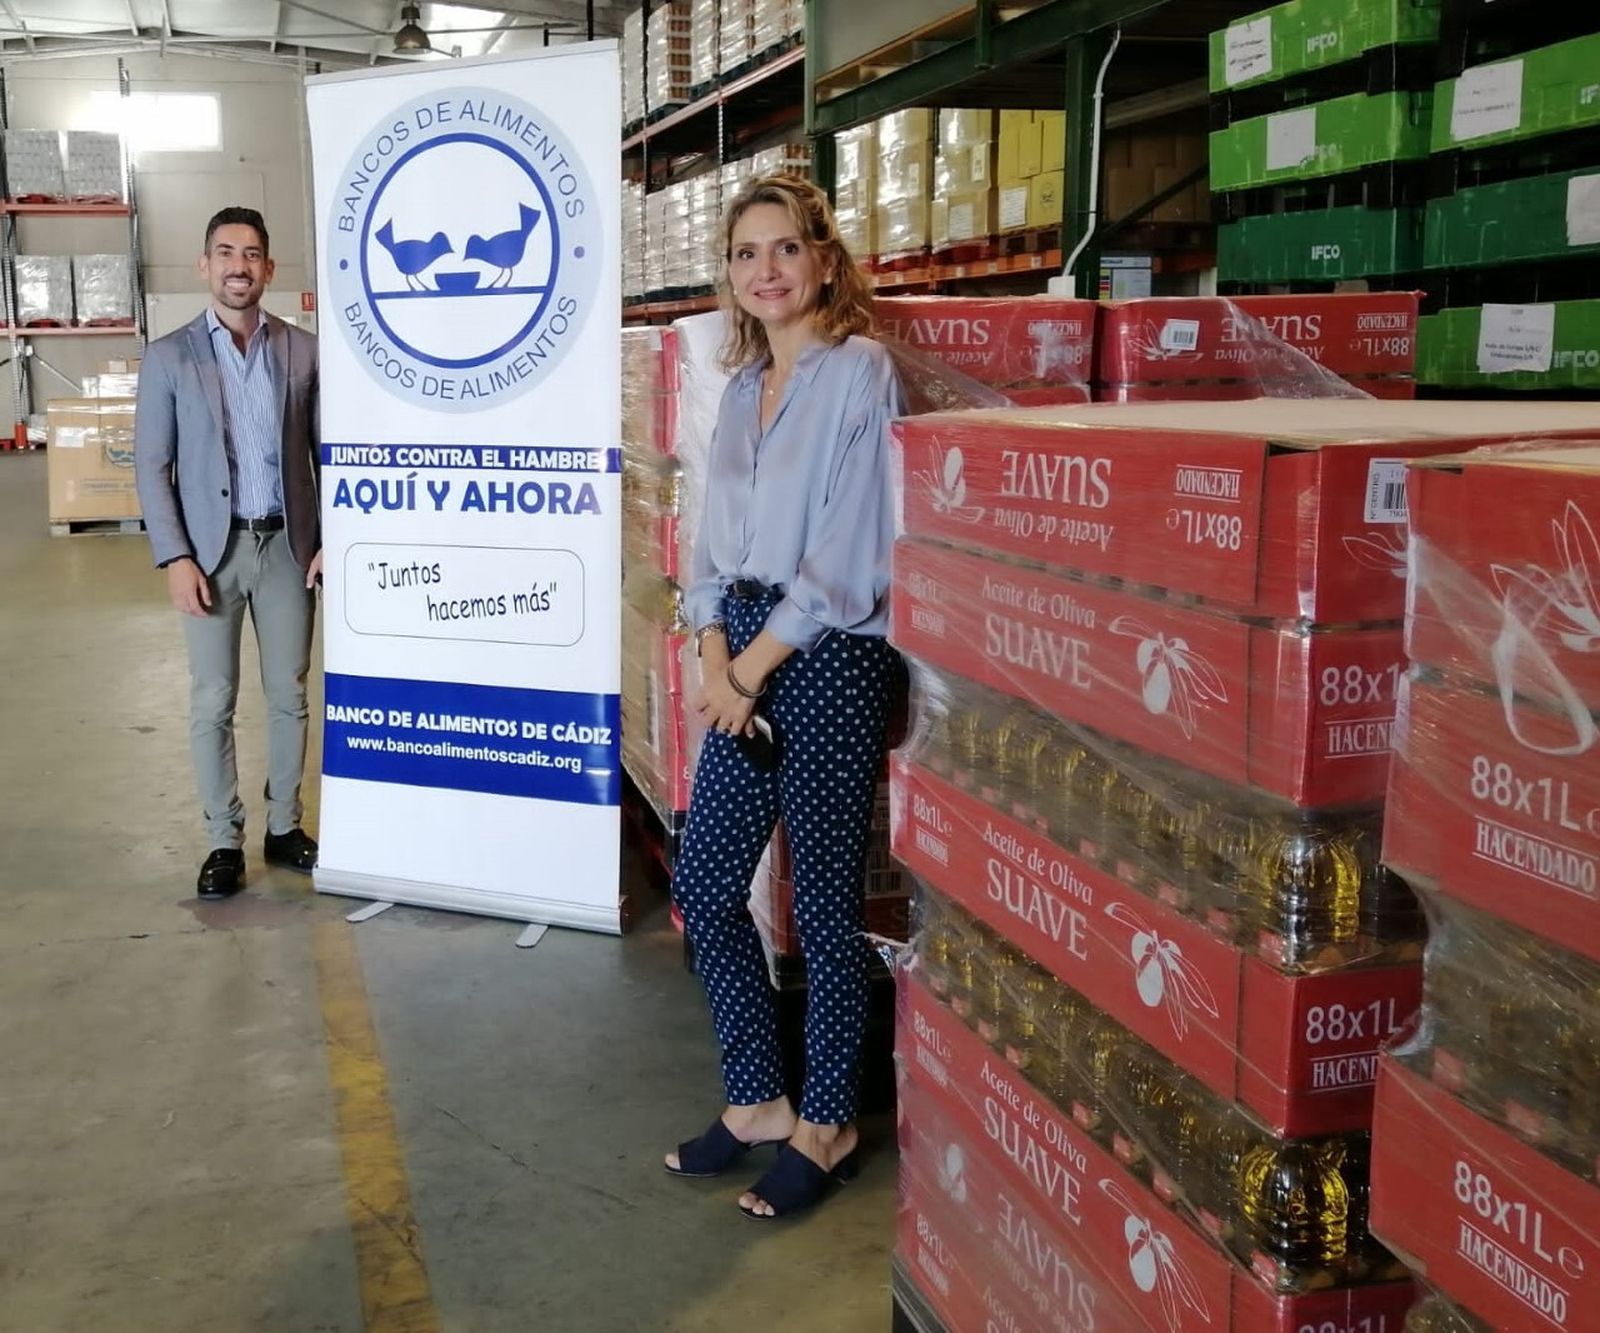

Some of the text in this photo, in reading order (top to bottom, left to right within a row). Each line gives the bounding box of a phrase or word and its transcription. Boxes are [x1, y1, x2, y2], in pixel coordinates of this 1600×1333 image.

[1307, 32, 1337, 54] IFCO
[338, 99, 585, 232] BANCOS DE ALIMENTOS
[1311, 245, 1340, 260] IFCO
[344, 295, 578, 401] BANCOS DE ALIMENTOS
[1554, 350, 1600, 368] IFCO
[330, 446, 599, 470] JUNTOS CONTRA EL HAMBRE
[1001, 450, 1112, 508] SUAVE
[1176, 468, 1240, 498] HACENDADO
[333, 471, 602, 515] AQUÍ Y AHORA
[994, 507, 1114, 552] Aceite de Oliva
[427, 594, 507, 622] hacemos
[982, 576, 1096, 629] Aceite de Oliva
[985, 613, 1091, 690] SUAVE
[326, 703, 612, 745] BANCO DE ALIMENTOS DE CÁDIZ
[347, 735, 583, 774] www.bancoalimentoscadiz.org
[982, 821, 1093, 906] Aceite de Oliva
[1476, 821, 1597, 893] HACENDADO
[987, 857, 1088, 961] SUAVE
[980, 1060, 1087, 1174] Aceite de Oliva
[984, 1096, 1081, 1226] SUAVE
[998, 1192, 1098, 1331] SUAVE
[1460, 1223, 1566, 1324] HACENDADO
